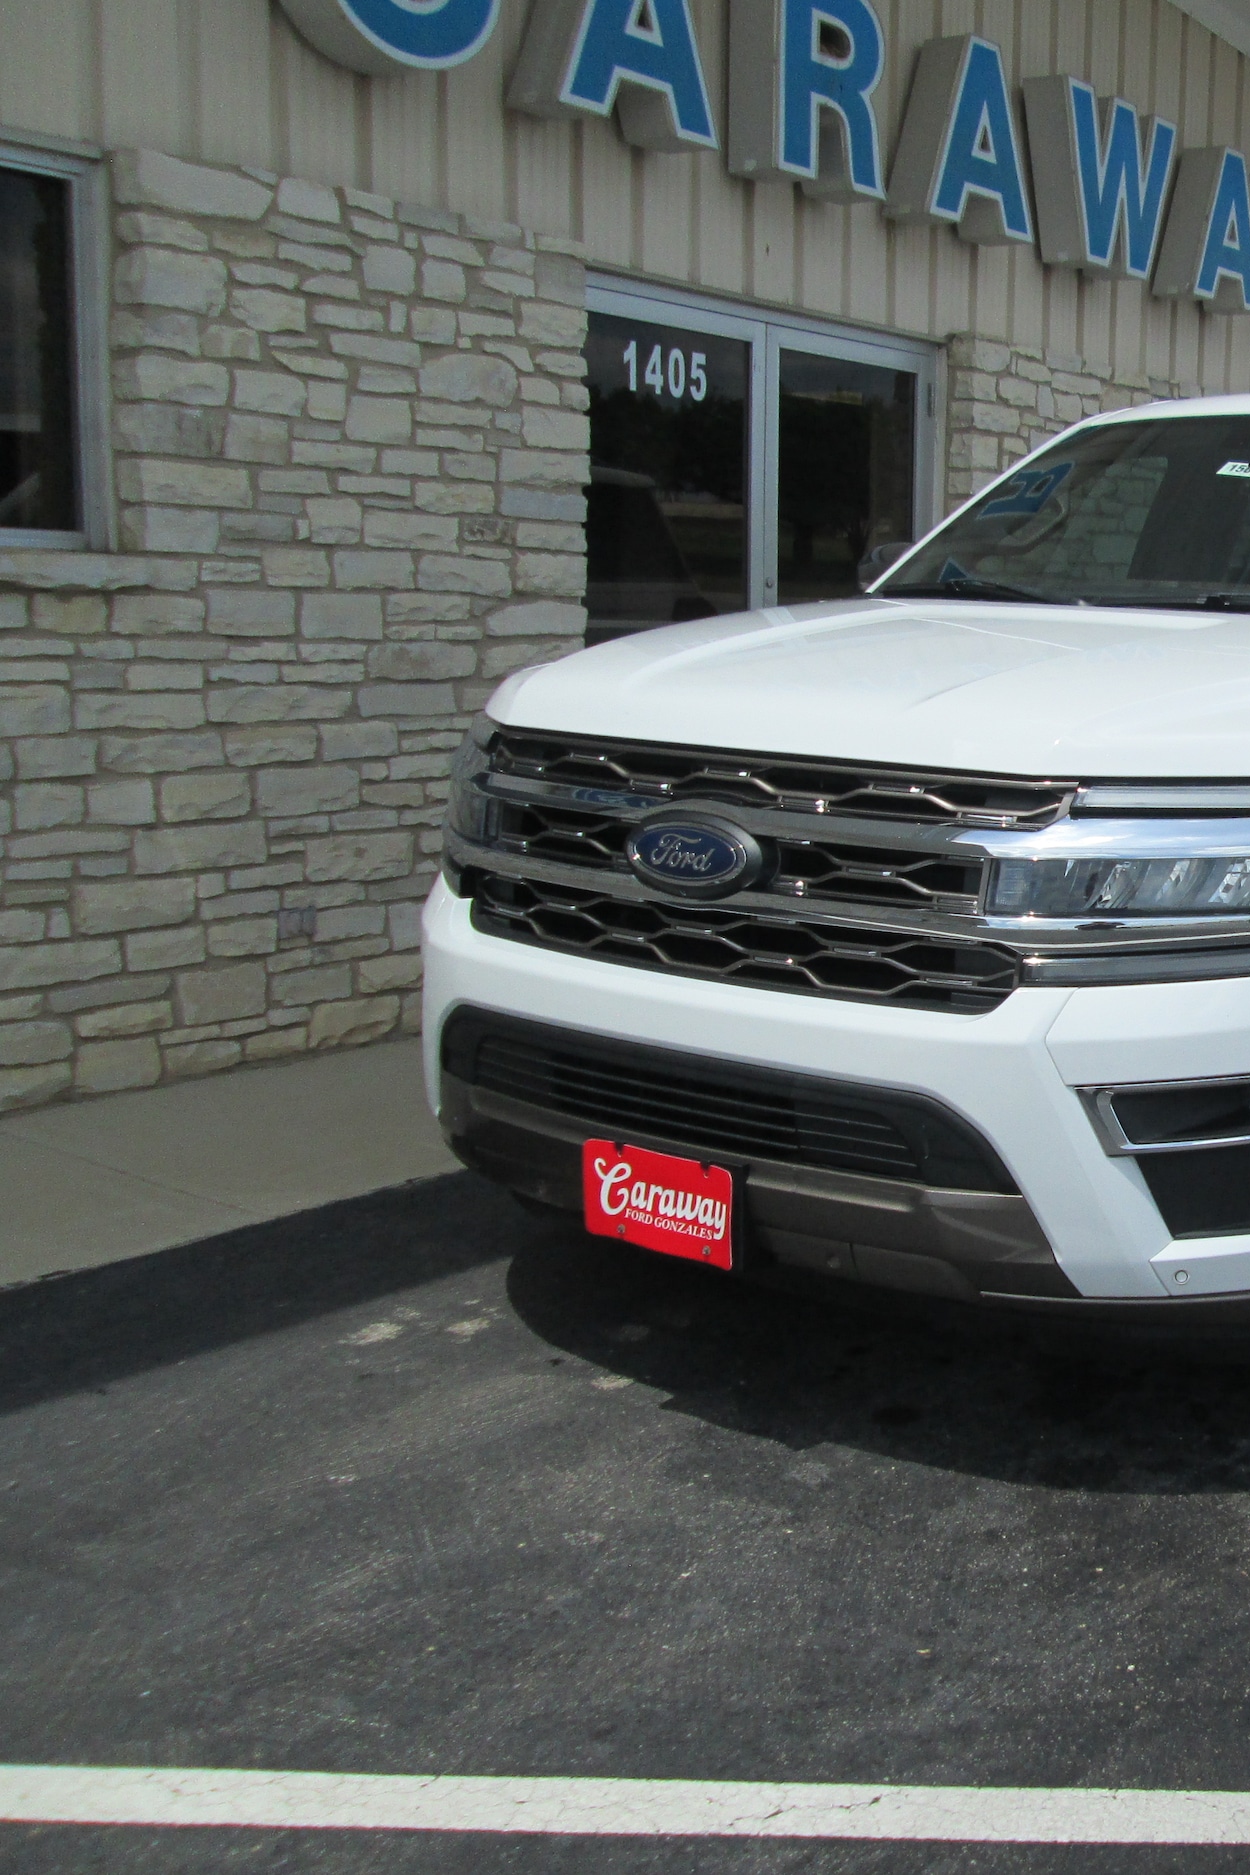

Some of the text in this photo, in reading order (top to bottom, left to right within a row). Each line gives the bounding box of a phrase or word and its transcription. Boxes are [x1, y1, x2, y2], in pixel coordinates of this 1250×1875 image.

[622, 340, 707, 402] 1405
[651, 833, 715, 872] Ford
[594, 1157, 727, 1240] Caraway
[624, 1209, 713, 1240] FORD GONZALES
